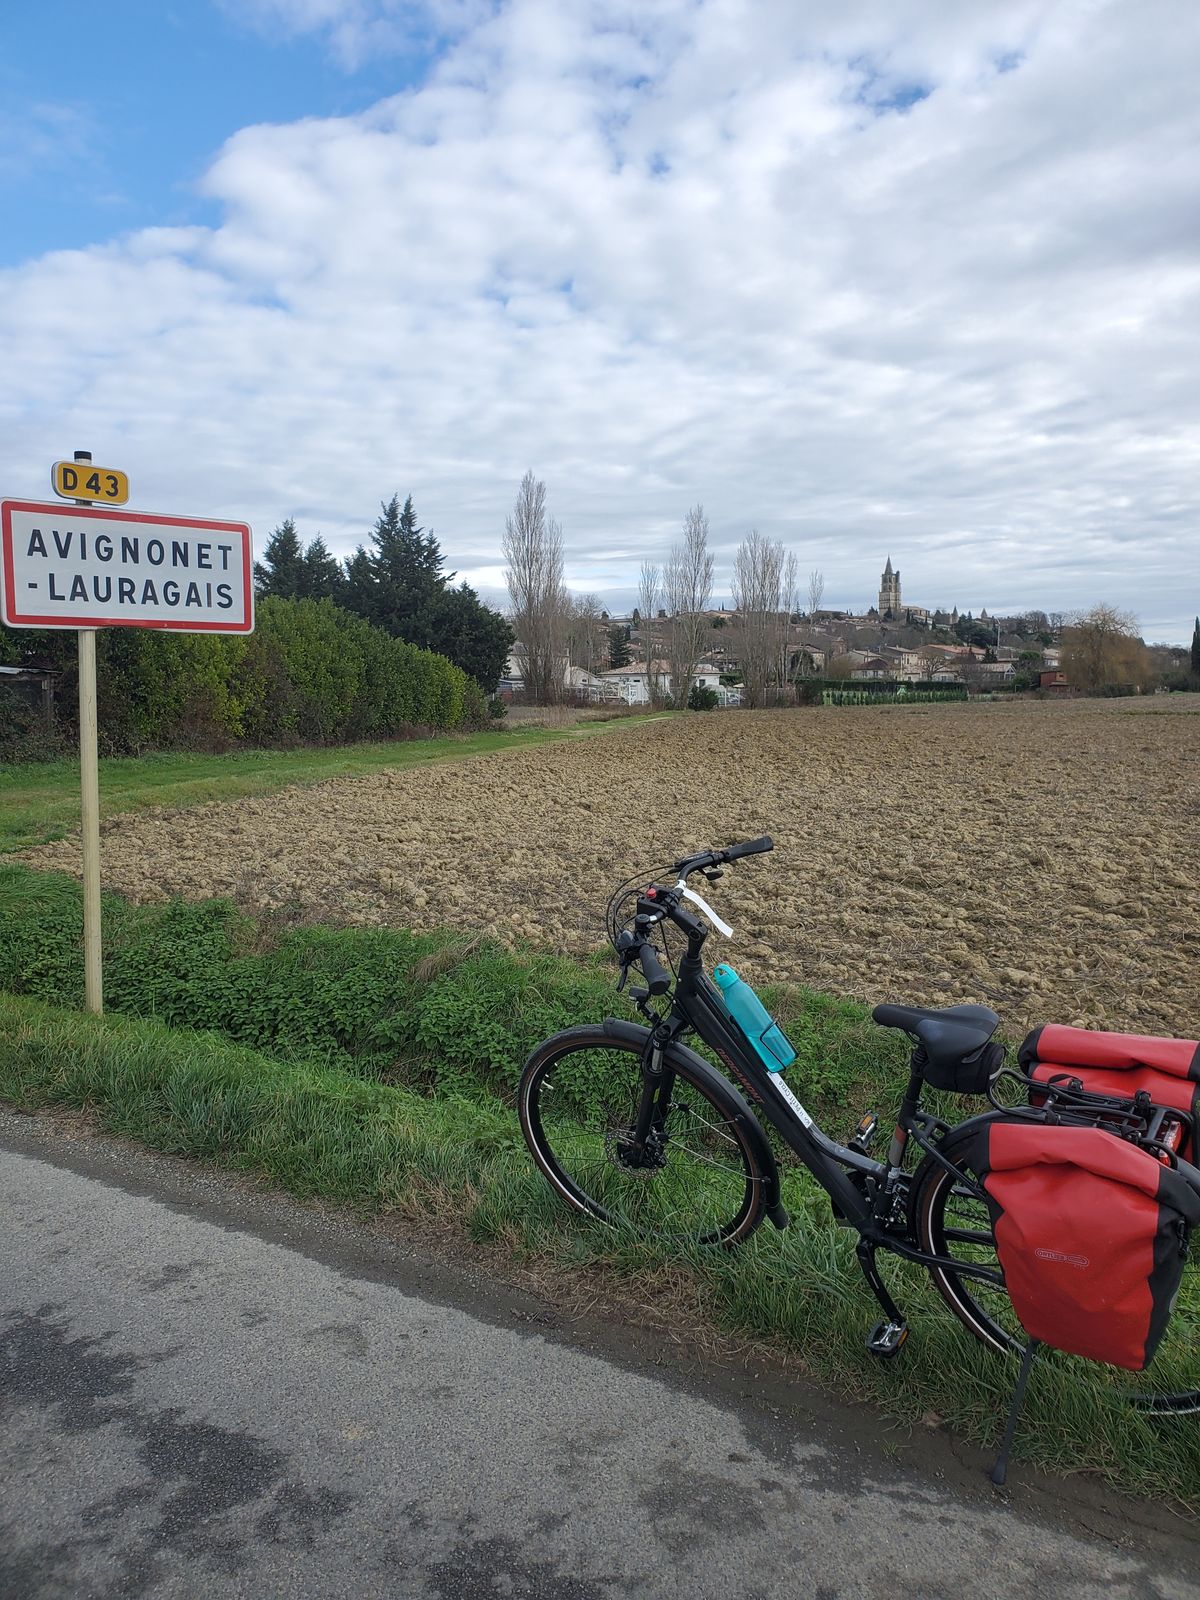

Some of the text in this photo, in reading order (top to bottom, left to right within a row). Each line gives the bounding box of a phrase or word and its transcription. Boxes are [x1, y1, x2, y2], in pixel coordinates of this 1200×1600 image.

[63, 468, 119, 497] D 43
[27, 529, 232, 570] AVIGNONET
[28, 573, 233, 609] -LAURAGAIS
